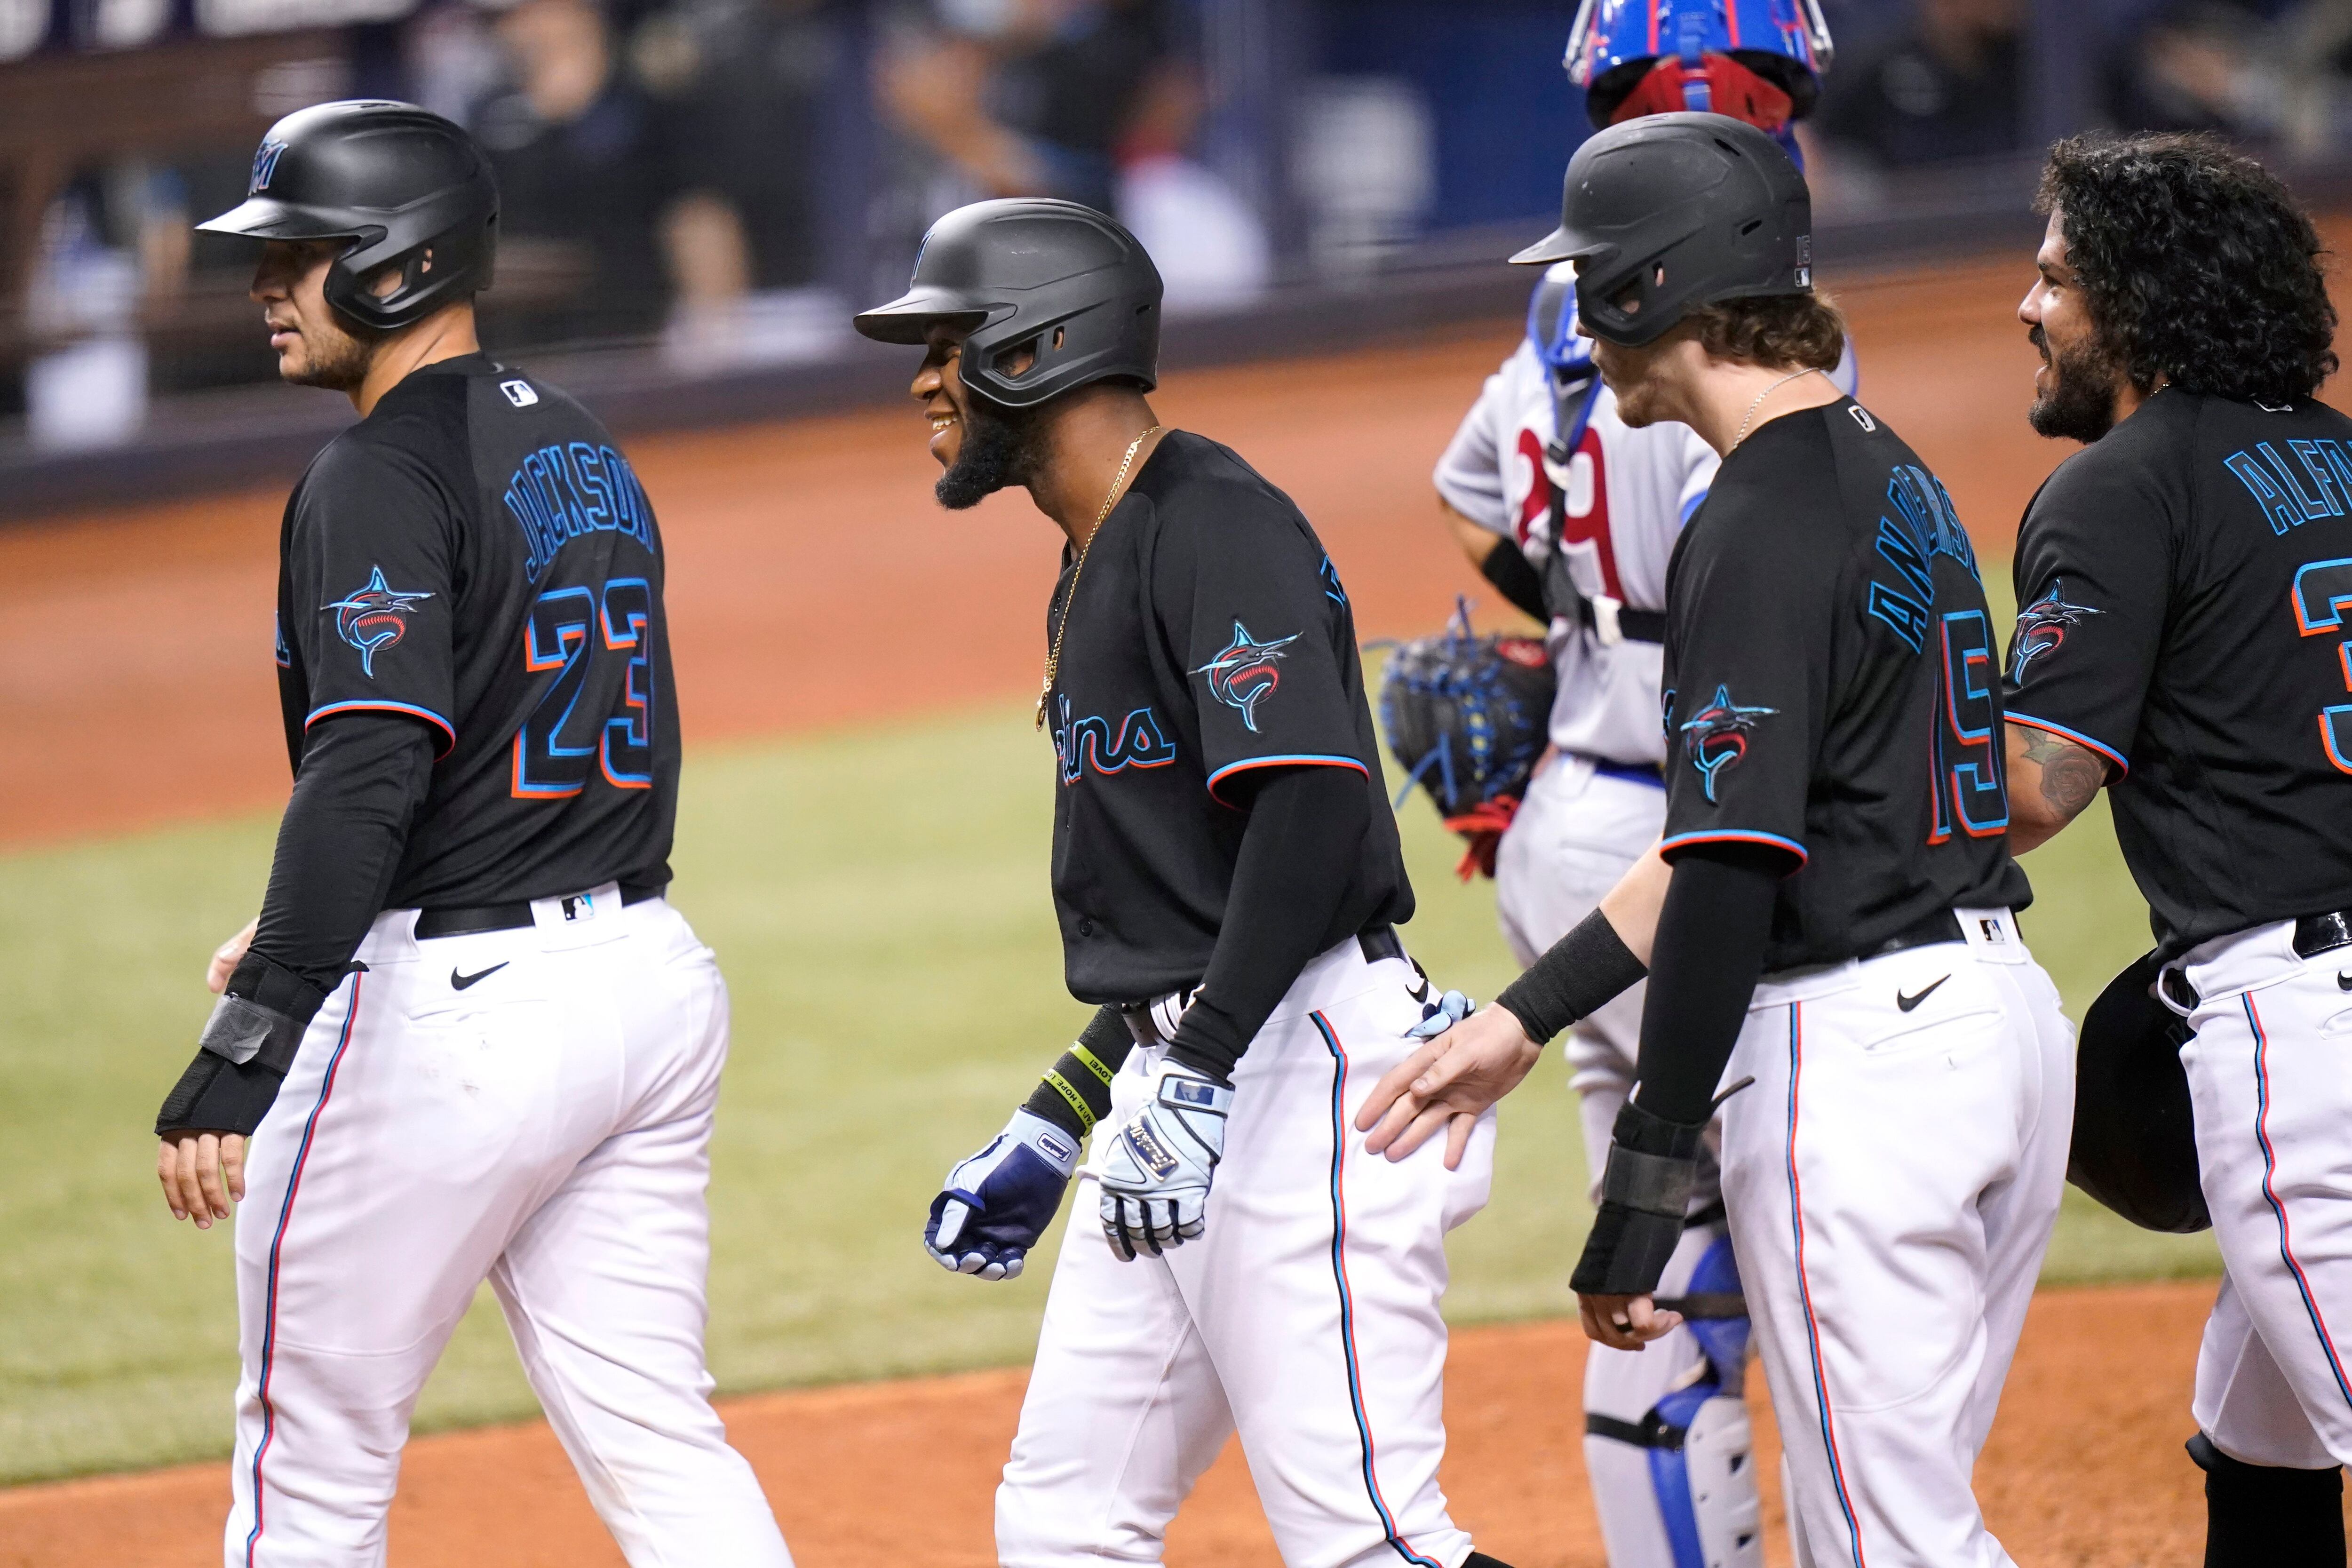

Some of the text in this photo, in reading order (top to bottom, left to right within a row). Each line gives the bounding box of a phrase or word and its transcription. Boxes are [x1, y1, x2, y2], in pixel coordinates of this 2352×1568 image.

[504, 441, 655, 584] JACKSON
[511, 577, 656, 798] 23
[1926, 609, 2009, 845] 15
